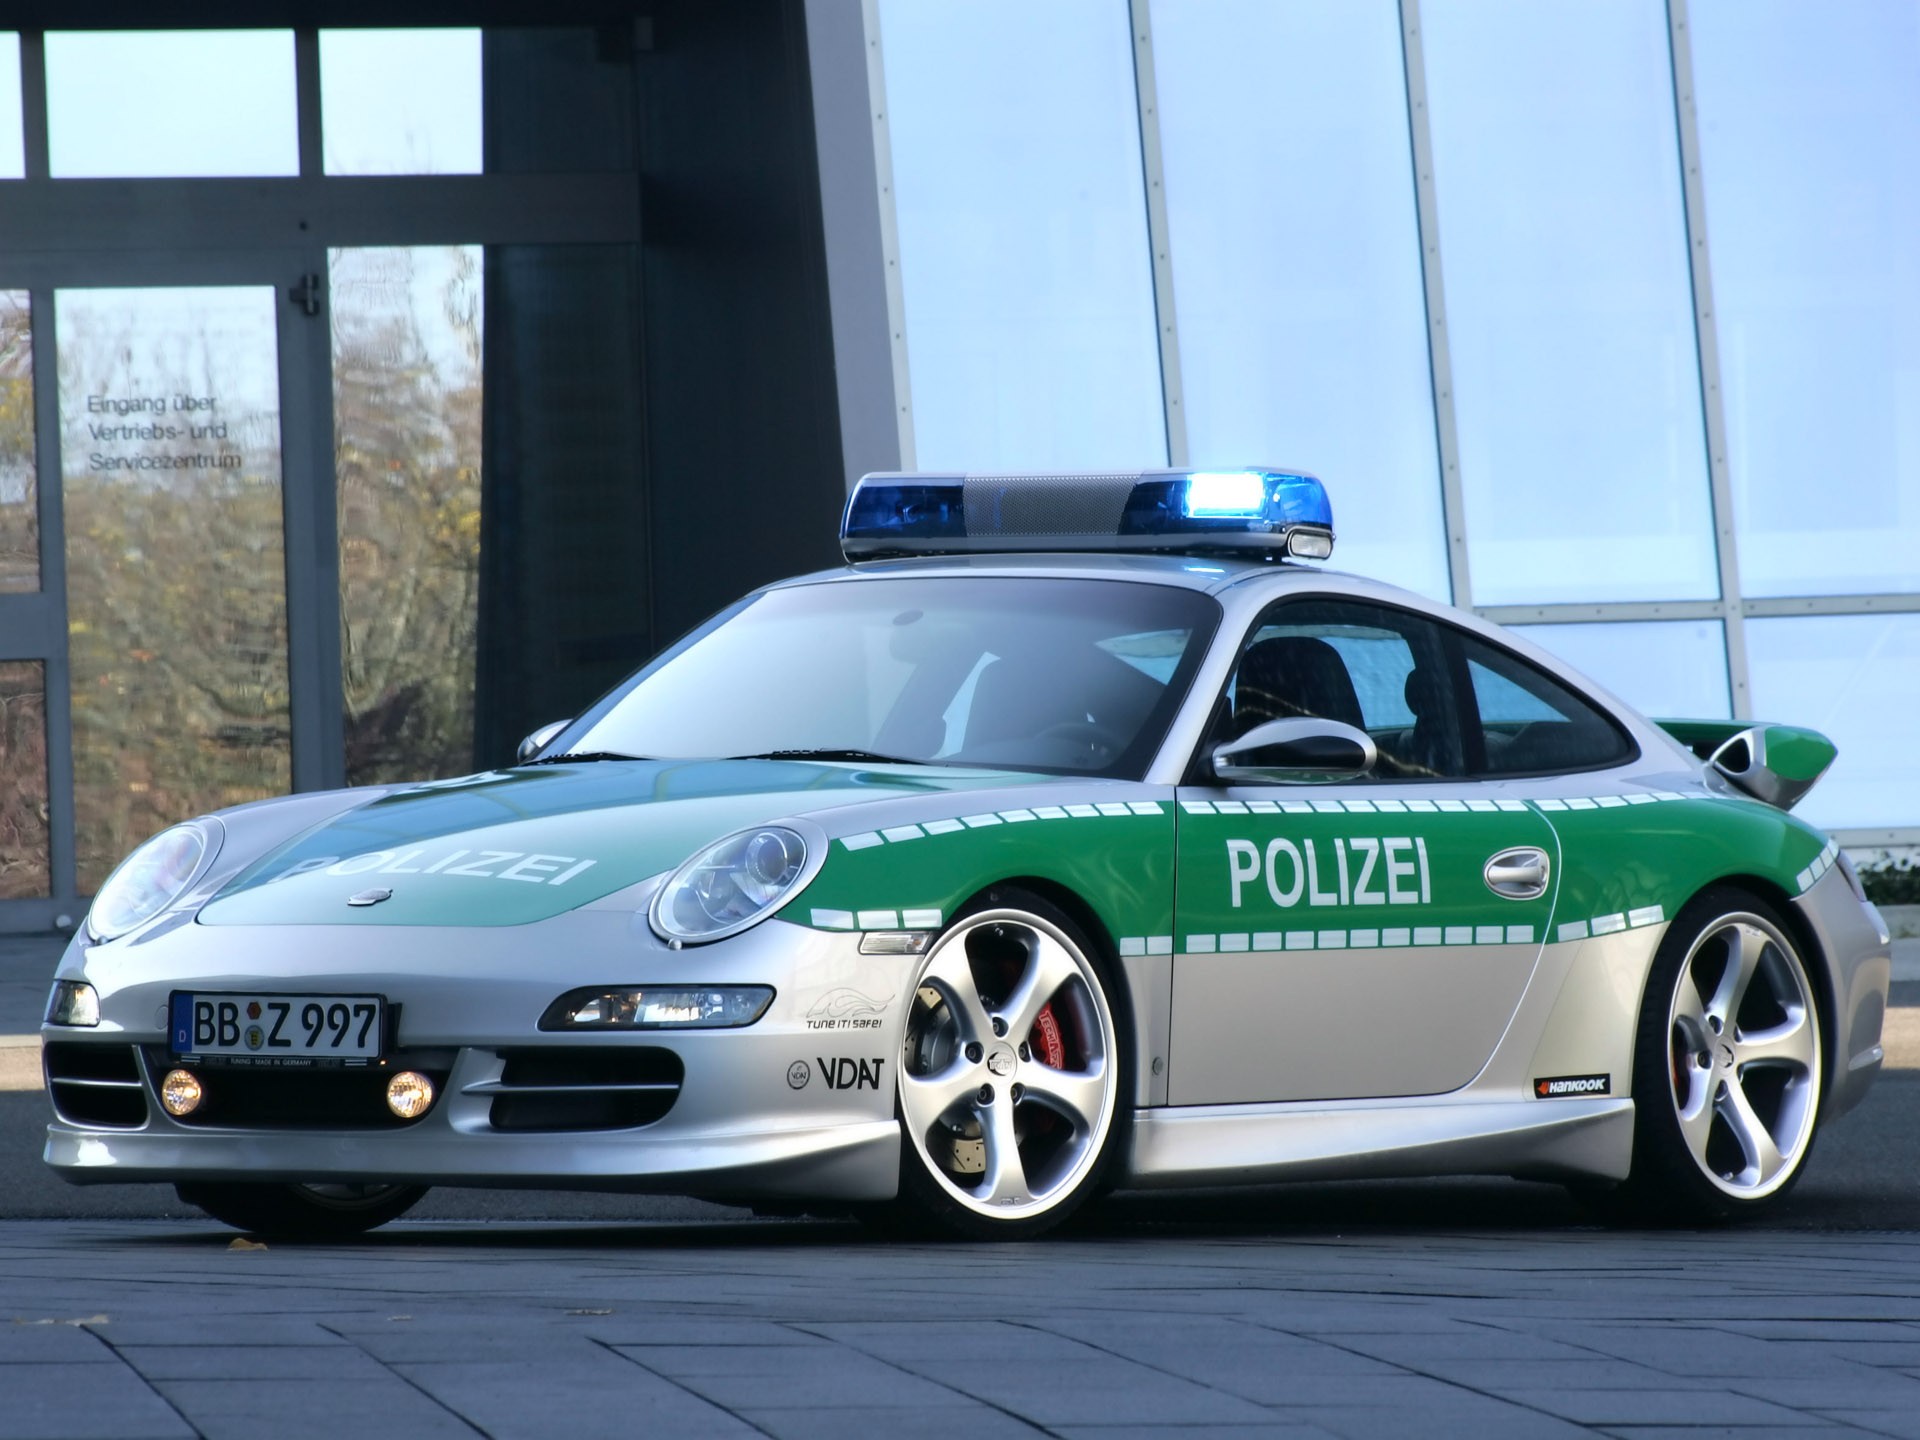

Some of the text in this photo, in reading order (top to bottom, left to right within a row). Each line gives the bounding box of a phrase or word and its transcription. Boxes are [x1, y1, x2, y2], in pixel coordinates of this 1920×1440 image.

[87, 394, 216, 416] Eingang über
[88, 421, 227, 440] Vertriebs- und
[90, 452, 241, 471] Servicezentrum
[267, 850, 597, 886] POLIZEI
[1226, 837, 1431, 907] POLIZEI
[194, 1002, 376, 1048] BB Z 997
[178, 1030, 186, 1043] D
[255, 1058, 271, 1066] MADE
[282, 1059, 311, 1067] GERMANY
[816, 1057, 885, 1090] VDAT
